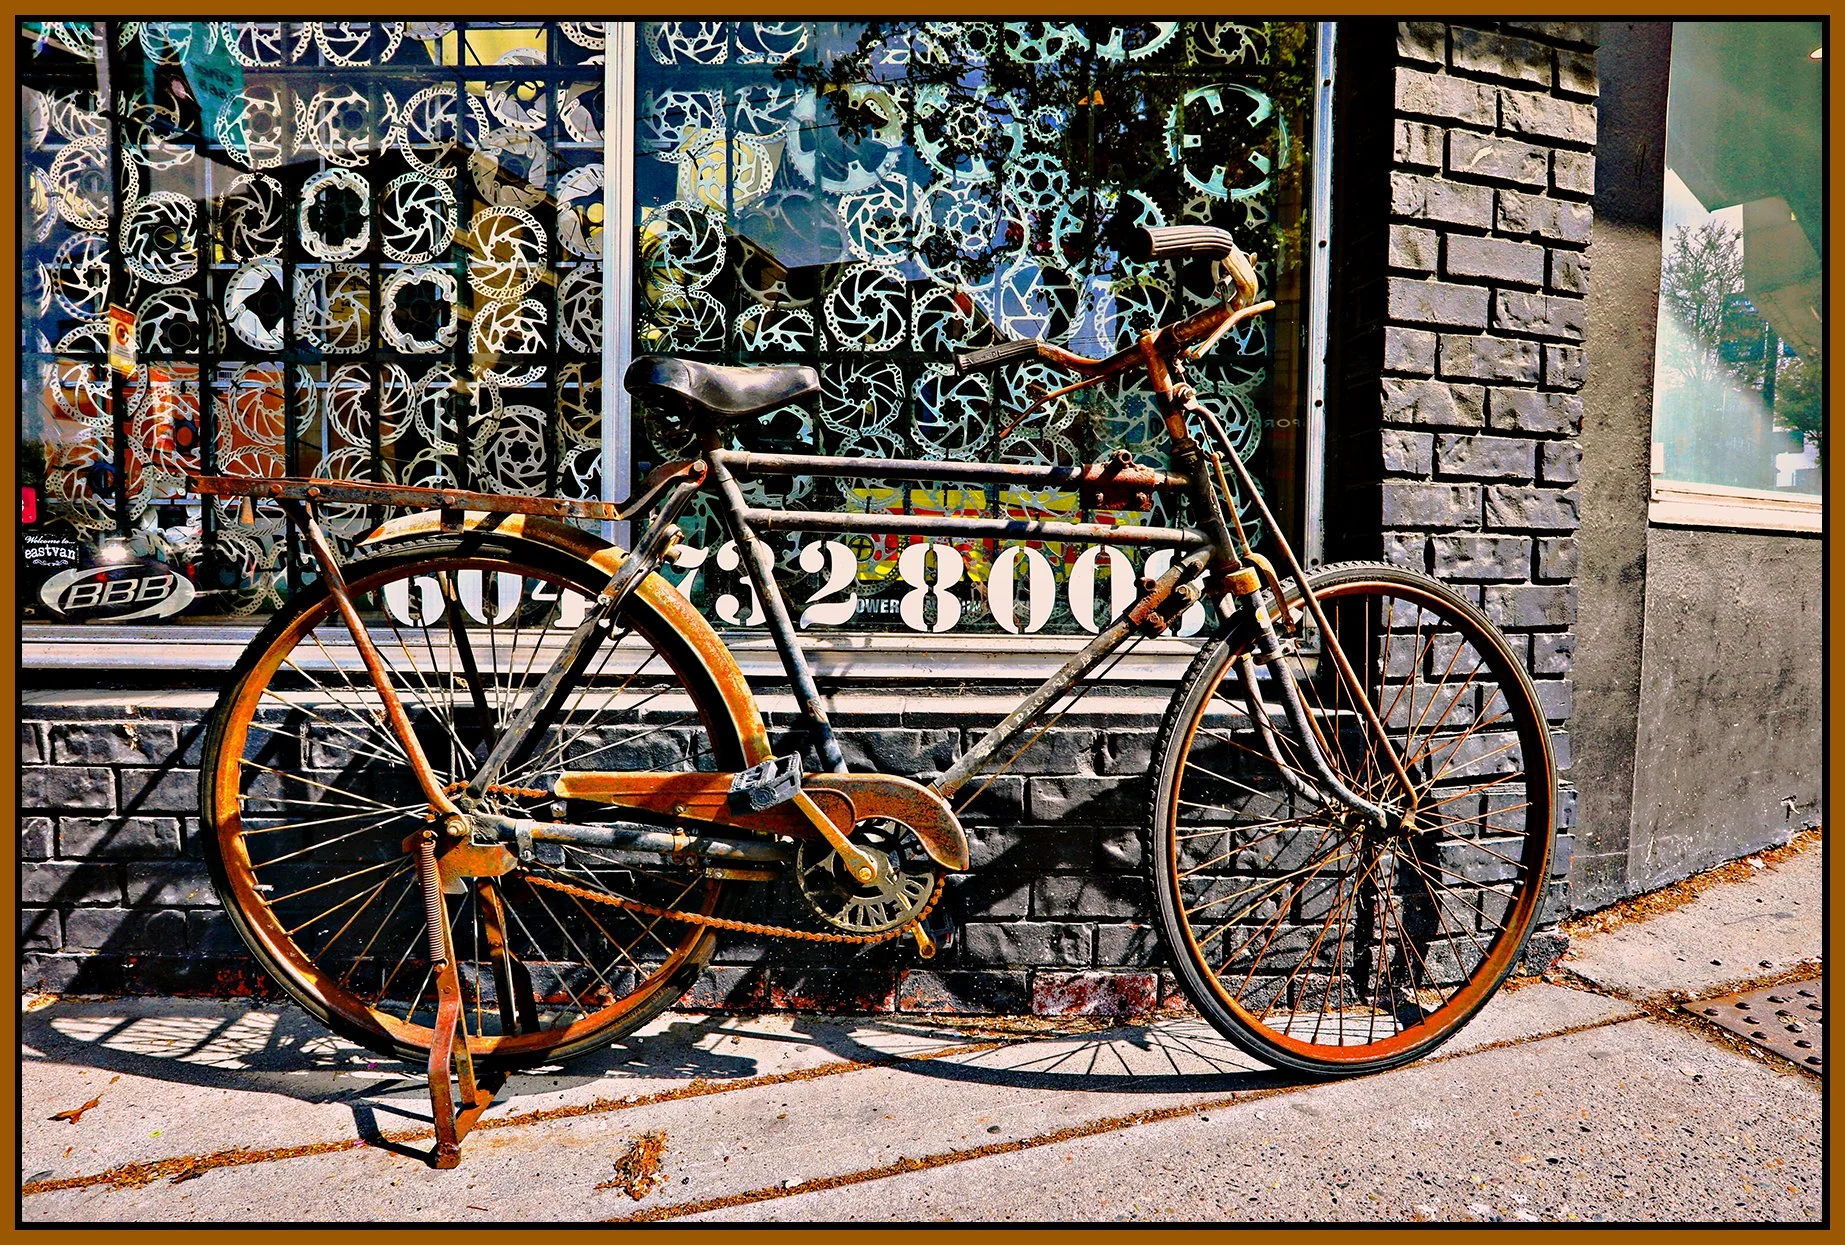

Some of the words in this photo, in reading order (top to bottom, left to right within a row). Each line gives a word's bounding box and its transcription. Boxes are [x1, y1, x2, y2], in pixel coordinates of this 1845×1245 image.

[24, 535, 61, 545] Welcome
[24, 544, 76, 560] eastvan
[63, 574, 174, 610] BBB
[382, 569, 597, 628] 604
[664, 539, 859, 630] 732
[851, 598, 900, 614] OWER
